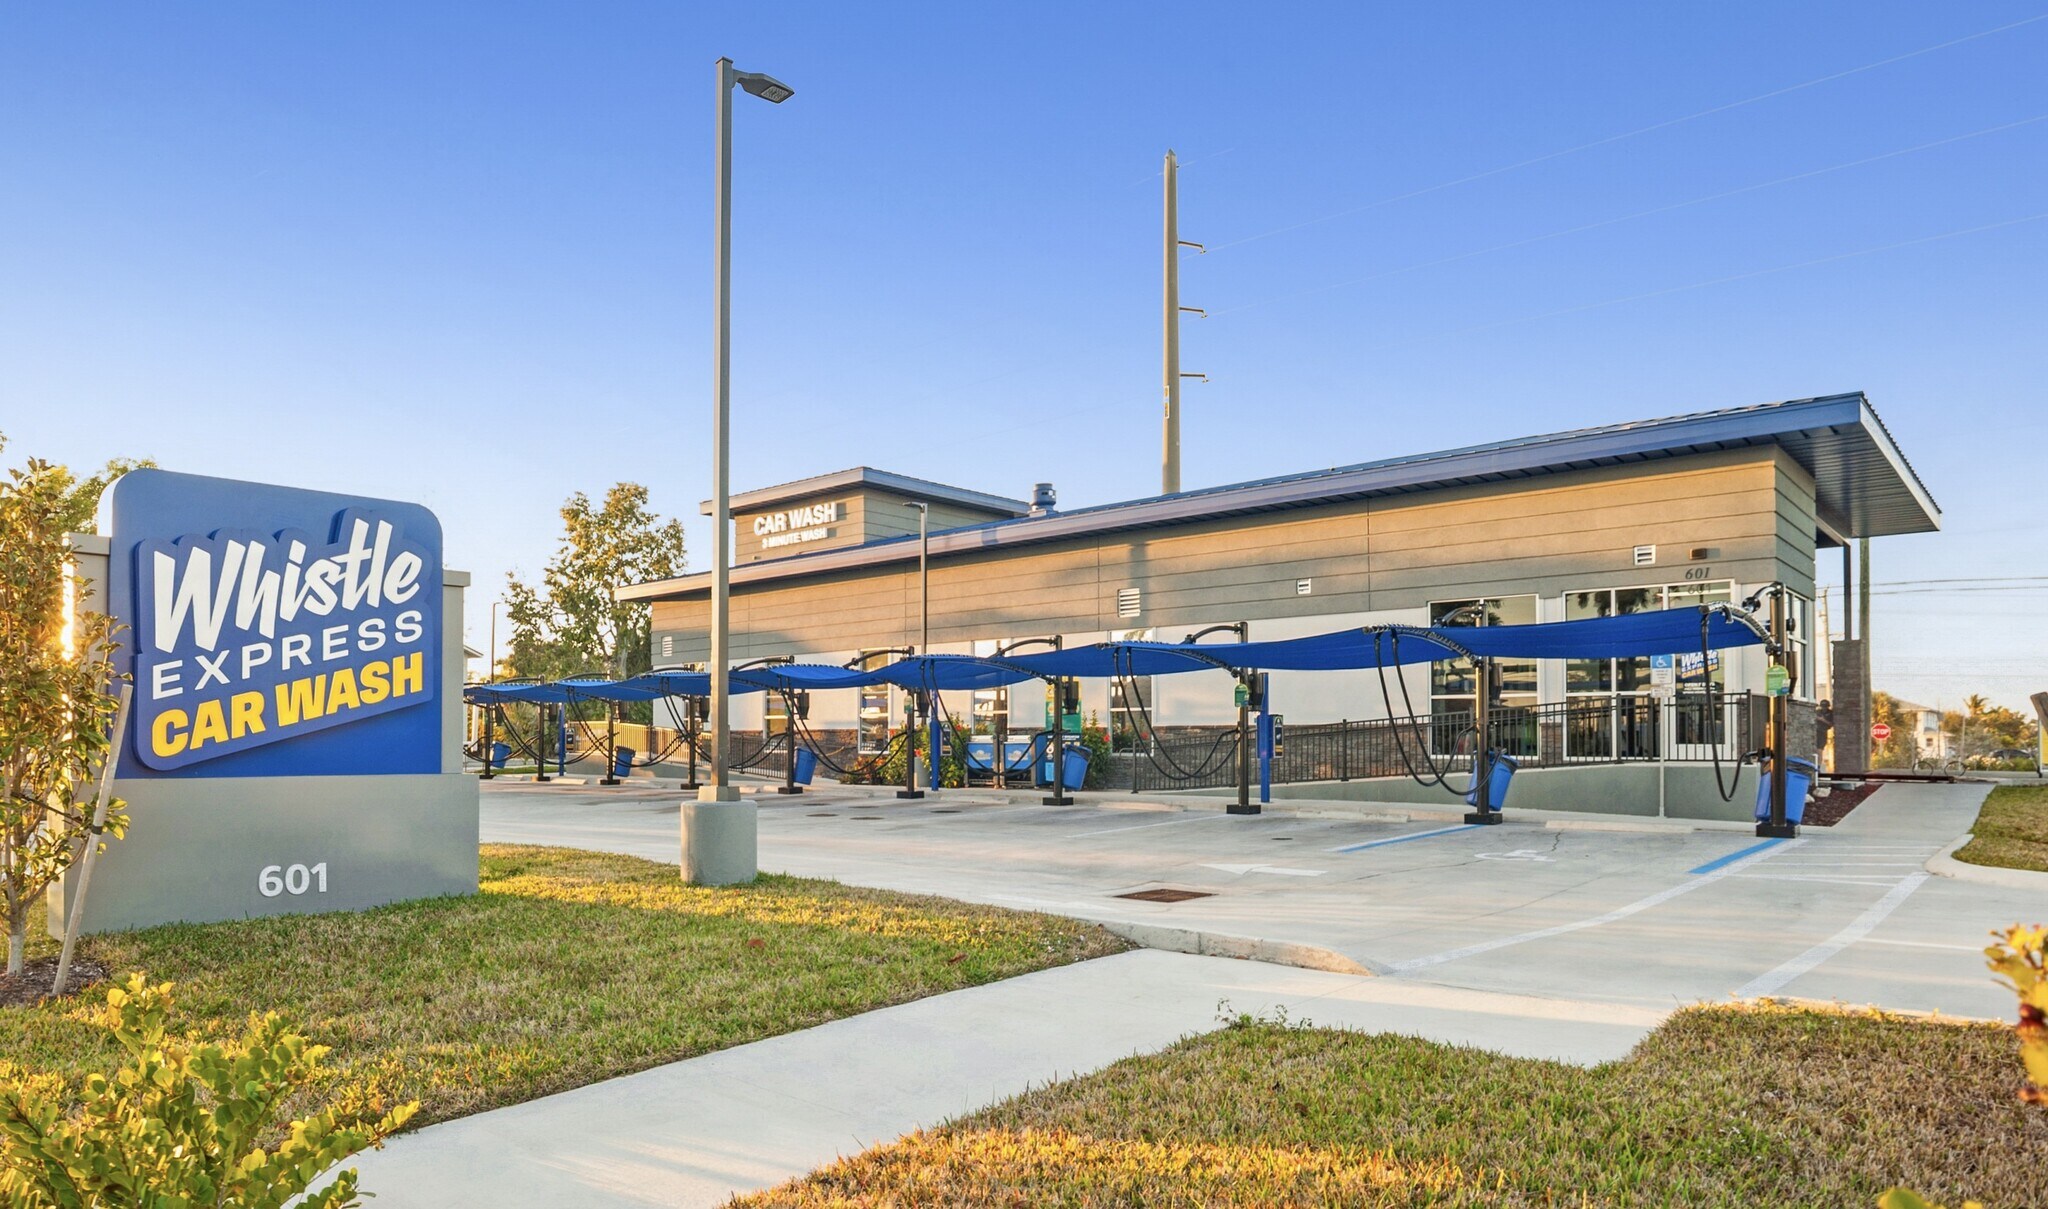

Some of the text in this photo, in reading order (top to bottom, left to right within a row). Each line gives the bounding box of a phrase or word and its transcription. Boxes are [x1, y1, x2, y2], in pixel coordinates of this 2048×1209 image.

[753, 502, 837, 536] CAR WASH
[768, 532, 801, 547] MINUTE
[801, 527, 828, 542] WASH
[153, 517, 423, 654] Whistle
[1685, 567, 1710, 580] 601
[152, 610, 423, 700] EXPRESS
[151, 651, 423, 758] CAR WASH
[258, 862, 327, 897] 601
